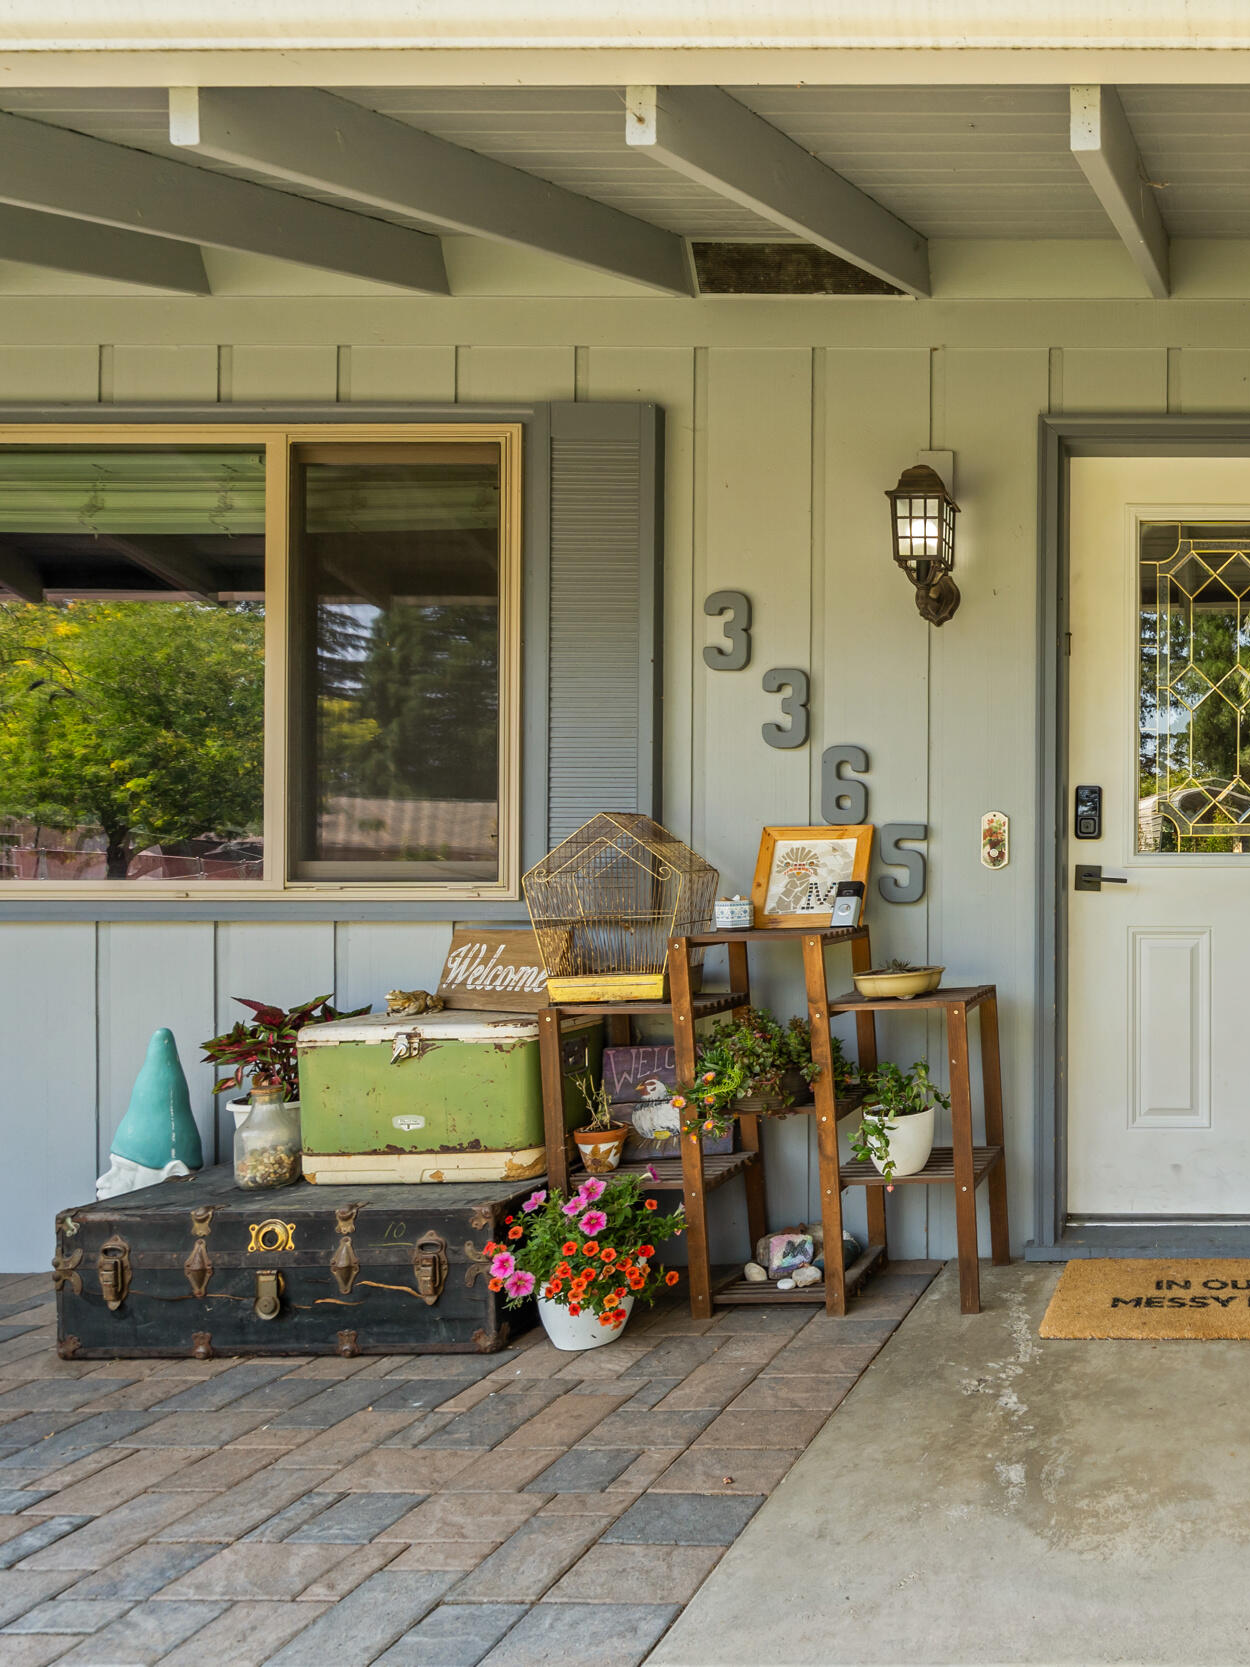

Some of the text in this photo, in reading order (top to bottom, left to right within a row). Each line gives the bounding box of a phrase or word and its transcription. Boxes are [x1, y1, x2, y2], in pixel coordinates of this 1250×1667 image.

[442, 943, 548, 992] Welcome
[607, 1047, 675, 1094] WELC
[1155, 1279, 1191, 1290] IN
[1111, 1296, 1237, 1308] MESSY
